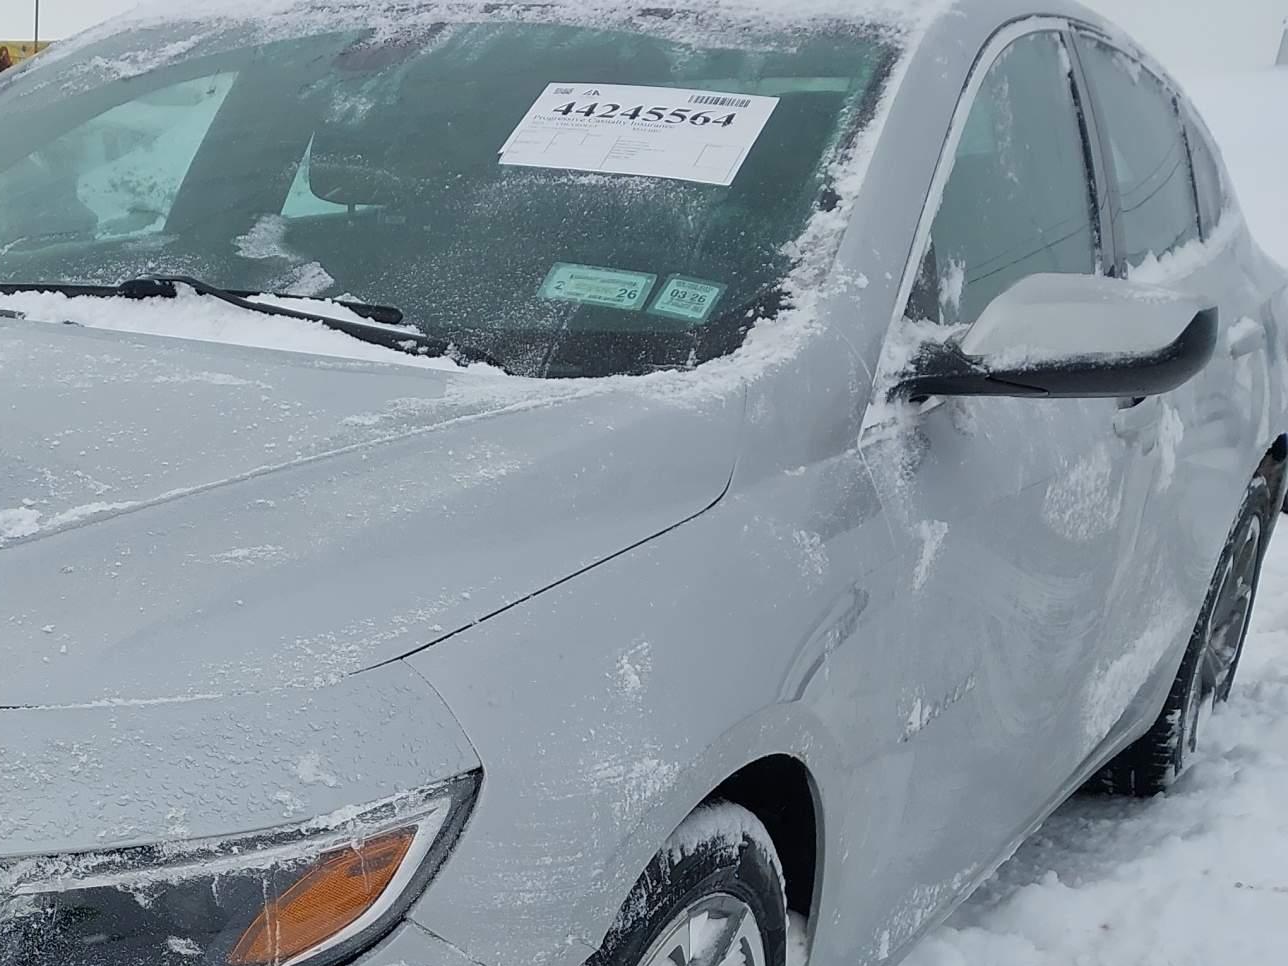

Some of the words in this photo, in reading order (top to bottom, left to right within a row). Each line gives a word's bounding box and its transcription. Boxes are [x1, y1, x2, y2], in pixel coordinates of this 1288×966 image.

[553, 101, 737, 128] 44245564
[615, 288, 638, 300] 26
[670, 288, 688, 299] 03
[690, 293, 708, 303] 26
